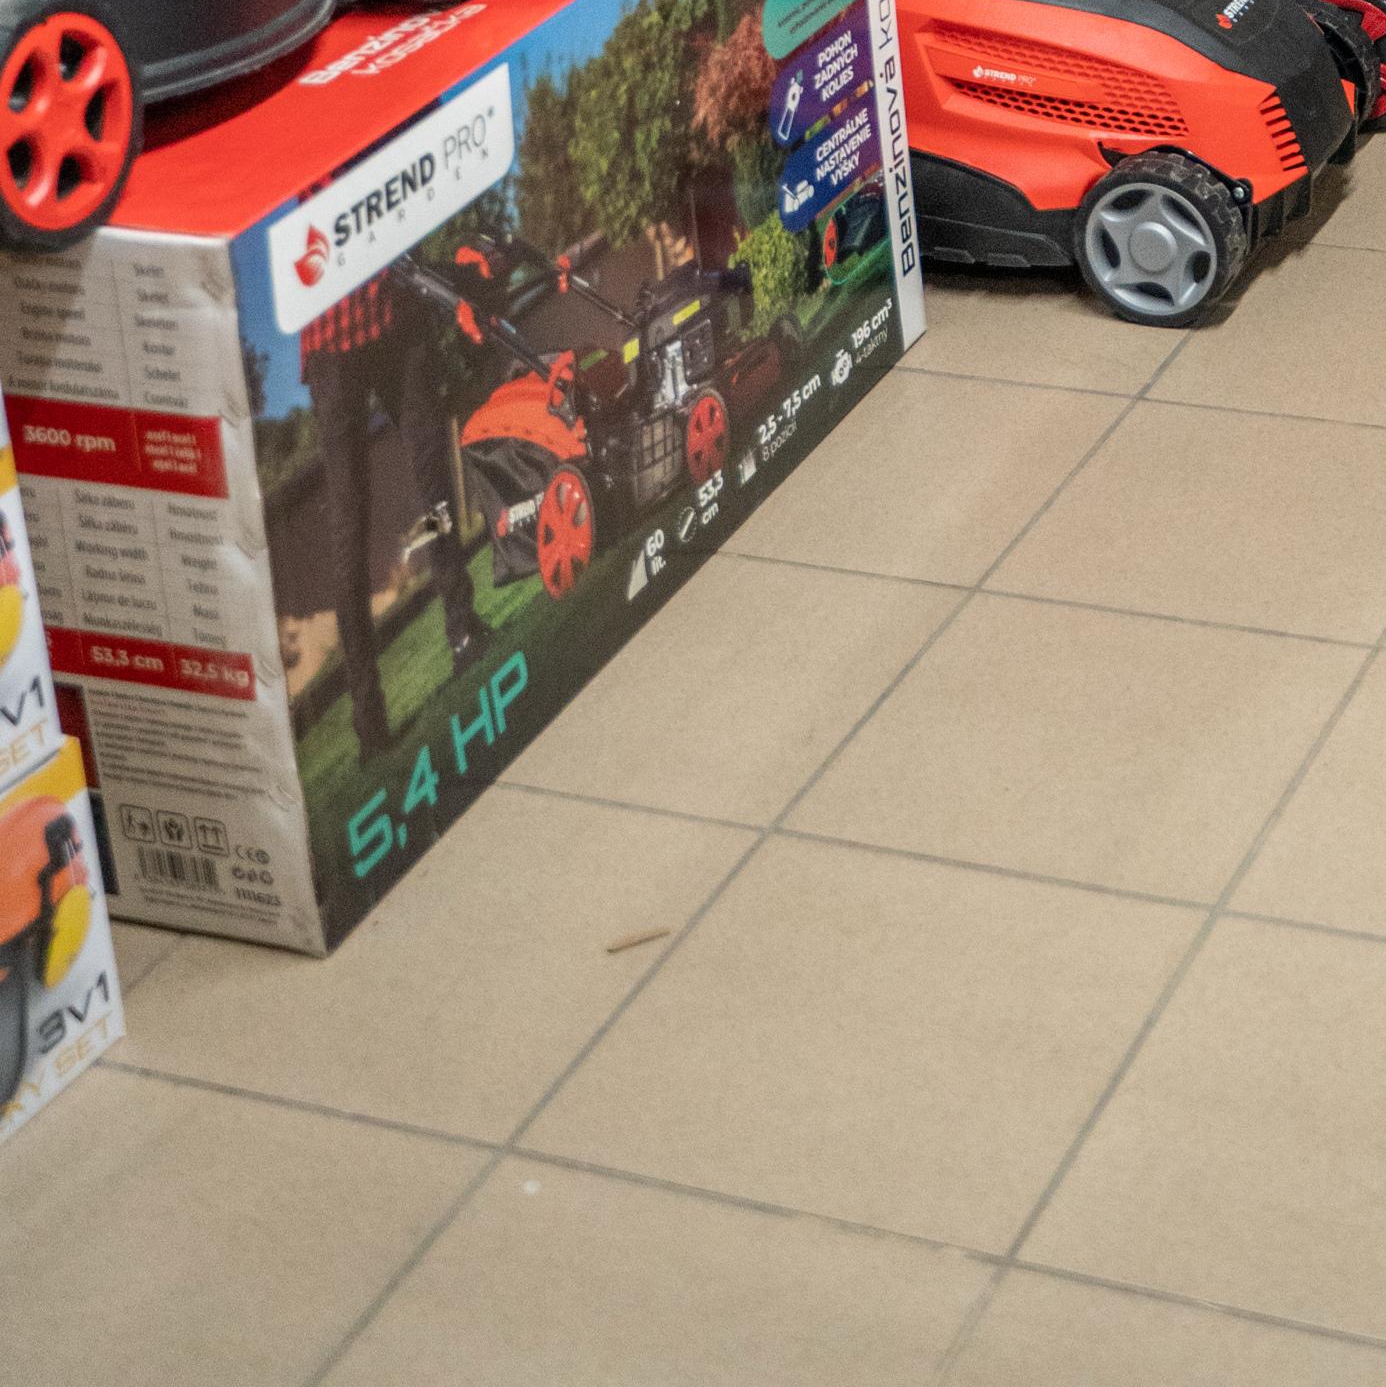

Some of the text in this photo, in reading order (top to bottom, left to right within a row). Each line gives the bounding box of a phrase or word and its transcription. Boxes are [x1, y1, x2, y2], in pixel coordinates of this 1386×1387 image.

[814, 43, 858, 90] ZADNÝCH
[817, 30, 852, 68] POHON
[822, 65, 855, 102] KOLIES
[984, 69, 1017, 82] STREND
[816, 108, 869, 162] CENTRÁLNE
[816, 125, 872, 182] NASTAVENIE
[830, 152, 861, 187] VÝŠKY
[333, 152, 436, 248] STREND
[851, 320, 872, 349] 196
[757, 414, 778, 445] 2,5
[782, 393, 802, 421] 7,5
[802, 373, 822, 399] cm
[23, 424, 117, 453] 3600 rpm
[698, 469, 724, 508] 53,3
[702, 502, 719, 525] cm
[645, 528, 665, 557] 60
[90, 645, 165, 672] 53,3 cm
[179, 659, 250, 689] 32,5 kg
[347, 650, 529, 878] 5,4 HP
